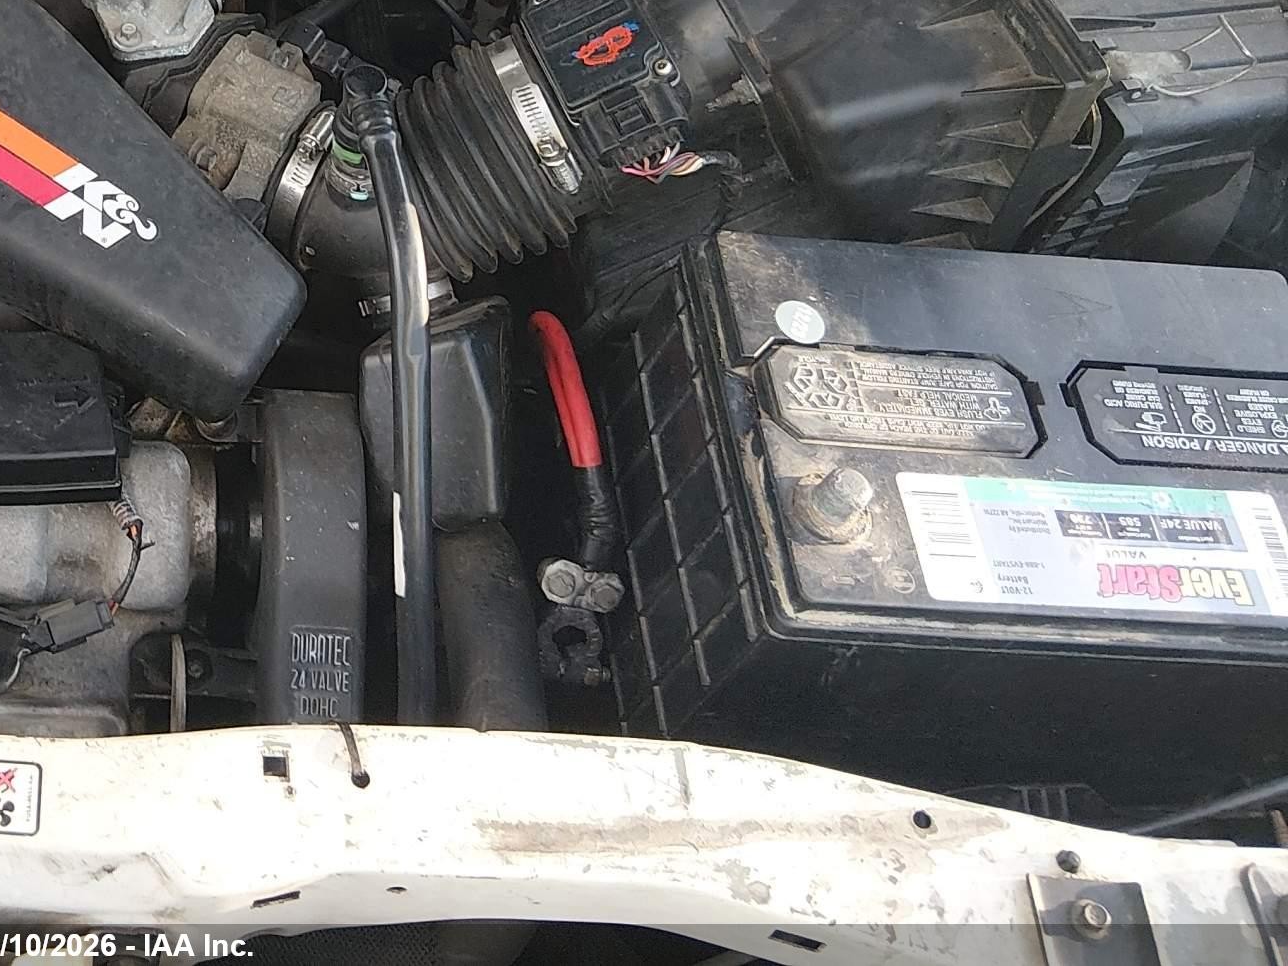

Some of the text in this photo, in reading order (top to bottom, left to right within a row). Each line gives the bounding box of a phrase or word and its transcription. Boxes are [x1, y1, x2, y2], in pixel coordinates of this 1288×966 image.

[920, 390, 940, 400] HELP
[944, 392, 977, 401] MEDICAL
[909, 398, 924, 406] GET
[958, 402, 980, 410] WITH
[1104, 398, 1164, 409] SULFURIC ACID
[1247, 402, 1274, 412] GASES
[878, 402, 983, 418] FLUSH EYES IMMEDIATELY
[1194, 405, 1206, 413] NO
[1234, 409, 1278, 418] EXPLOSIVE
[1240, 418, 1262, 426] EYES
[1236, 424, 1265, 434] SHIELD
[1140, 434, 1200, 450] POISON
[1214, 439, 1279, 455] DANGER
[1184, 518, 1222, 531] VALUE
[997, 574, 1028, 584] Battery
[1097, 564, 1254, 606] EverStart
[292, 633, 351, 666] DURATEC
[290, 669, 350, 692] 24 VALVE
[300, 696, 338, 718] DOHC
